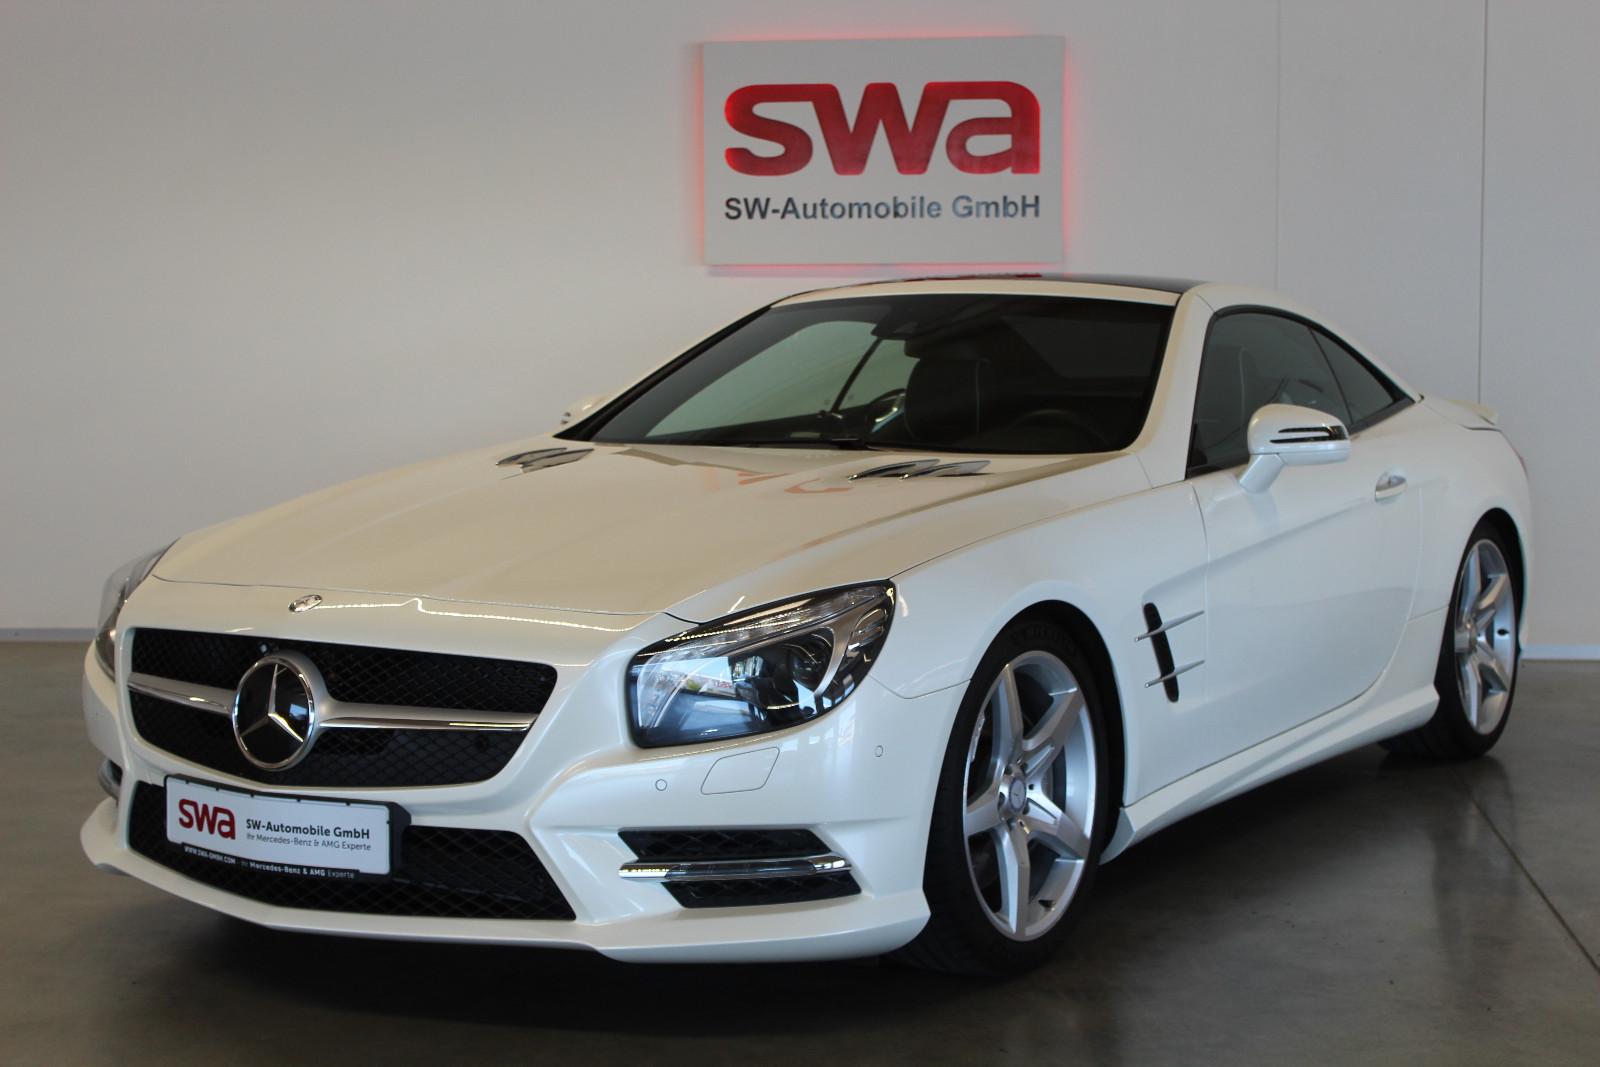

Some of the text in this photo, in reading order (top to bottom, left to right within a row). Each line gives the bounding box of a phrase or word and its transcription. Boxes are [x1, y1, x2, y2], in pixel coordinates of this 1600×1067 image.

[724, 195, 1040, 220] SW-Automobile GmbH
[246, 819, 370, 840] SW-Automobile GmbH
[256, 834, 313, 847] Mercedes-Benz
[321, 840, 341, 849] AMG
[341, 842, 372, 851] Experte
[249, 861, 301, 874] Mercedes-Benz
[310, 868, 326, 877] AMG
